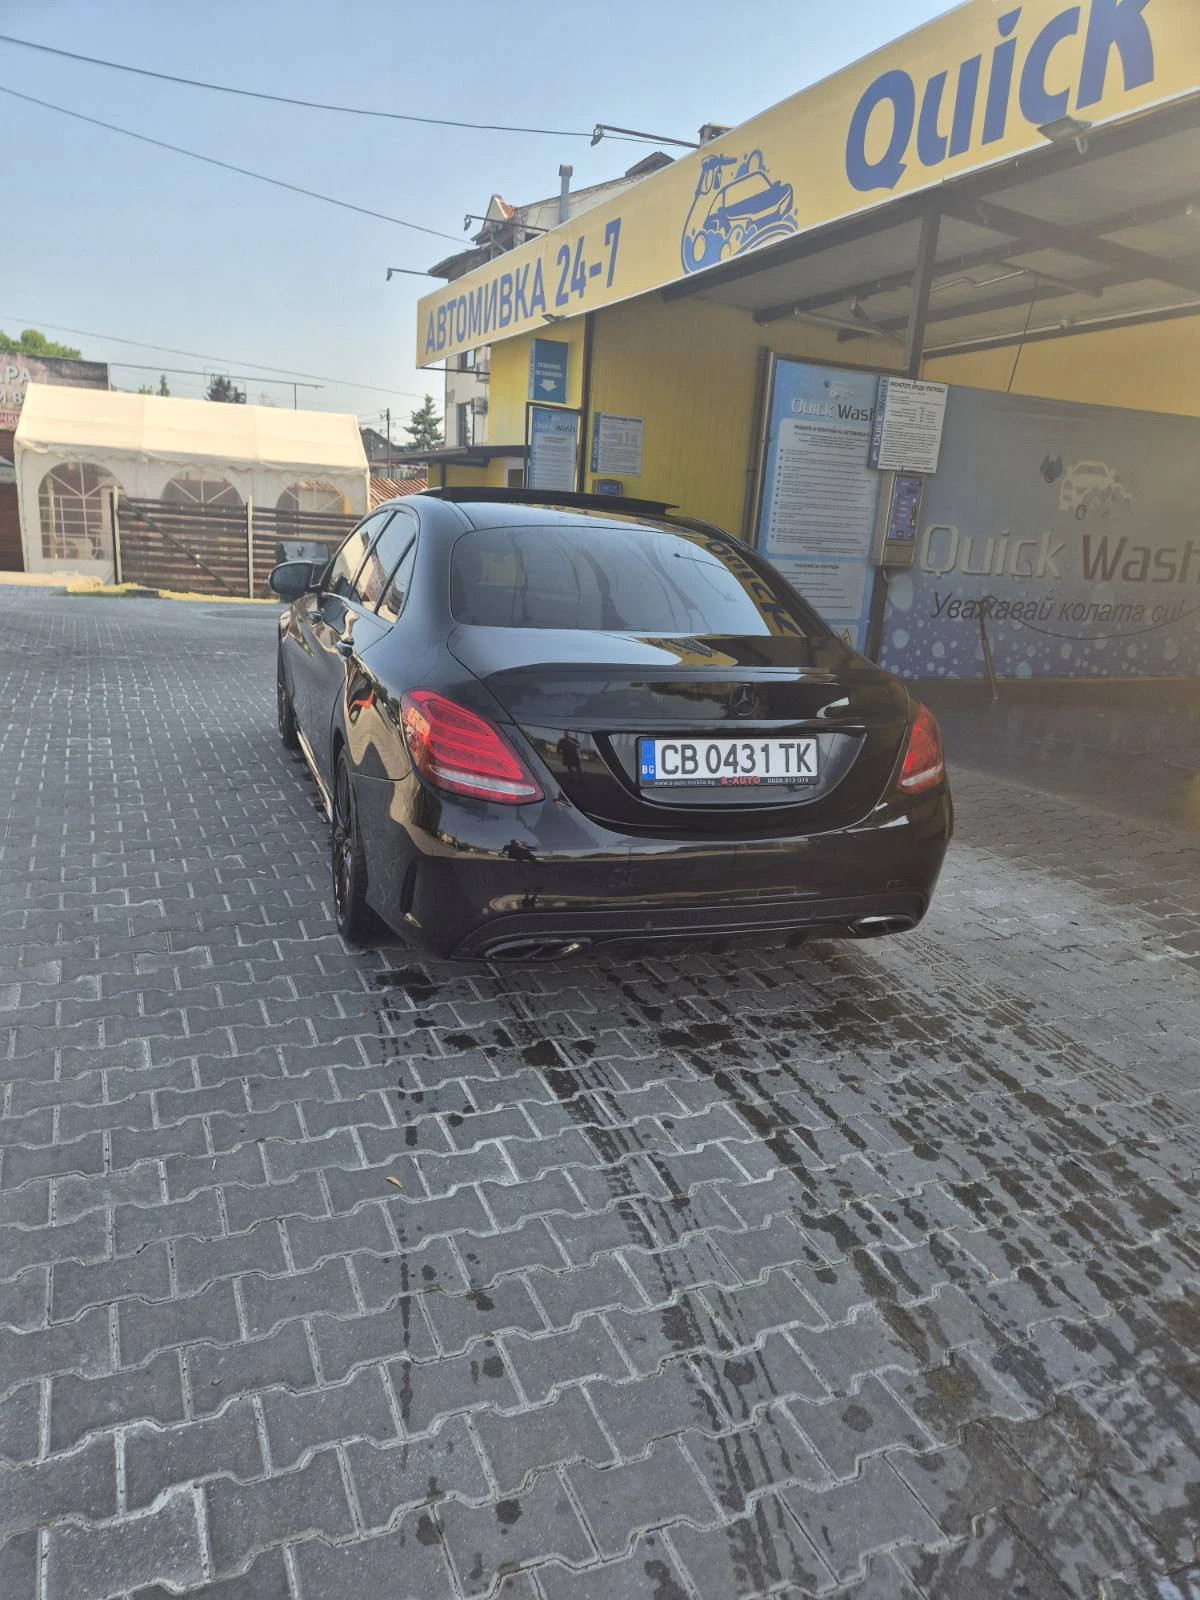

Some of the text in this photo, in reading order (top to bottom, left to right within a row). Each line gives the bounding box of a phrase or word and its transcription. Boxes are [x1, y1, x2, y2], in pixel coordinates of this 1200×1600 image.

[845, 0, 1154, 192] Quick
[425, 217, 621, 354] АВТОМИВКА 24-7
[0, 365, 32, 384] РА
[791, 398, 834, 417] Quick
[919, 524, 1067, 579] Quick
[1058, 602, 1145, 622] колата
[661, 742, 812, 775] CB 0431 TK
[641, 764, 655, 775] BG
[720, 775, 760, 786] S-AUTO
